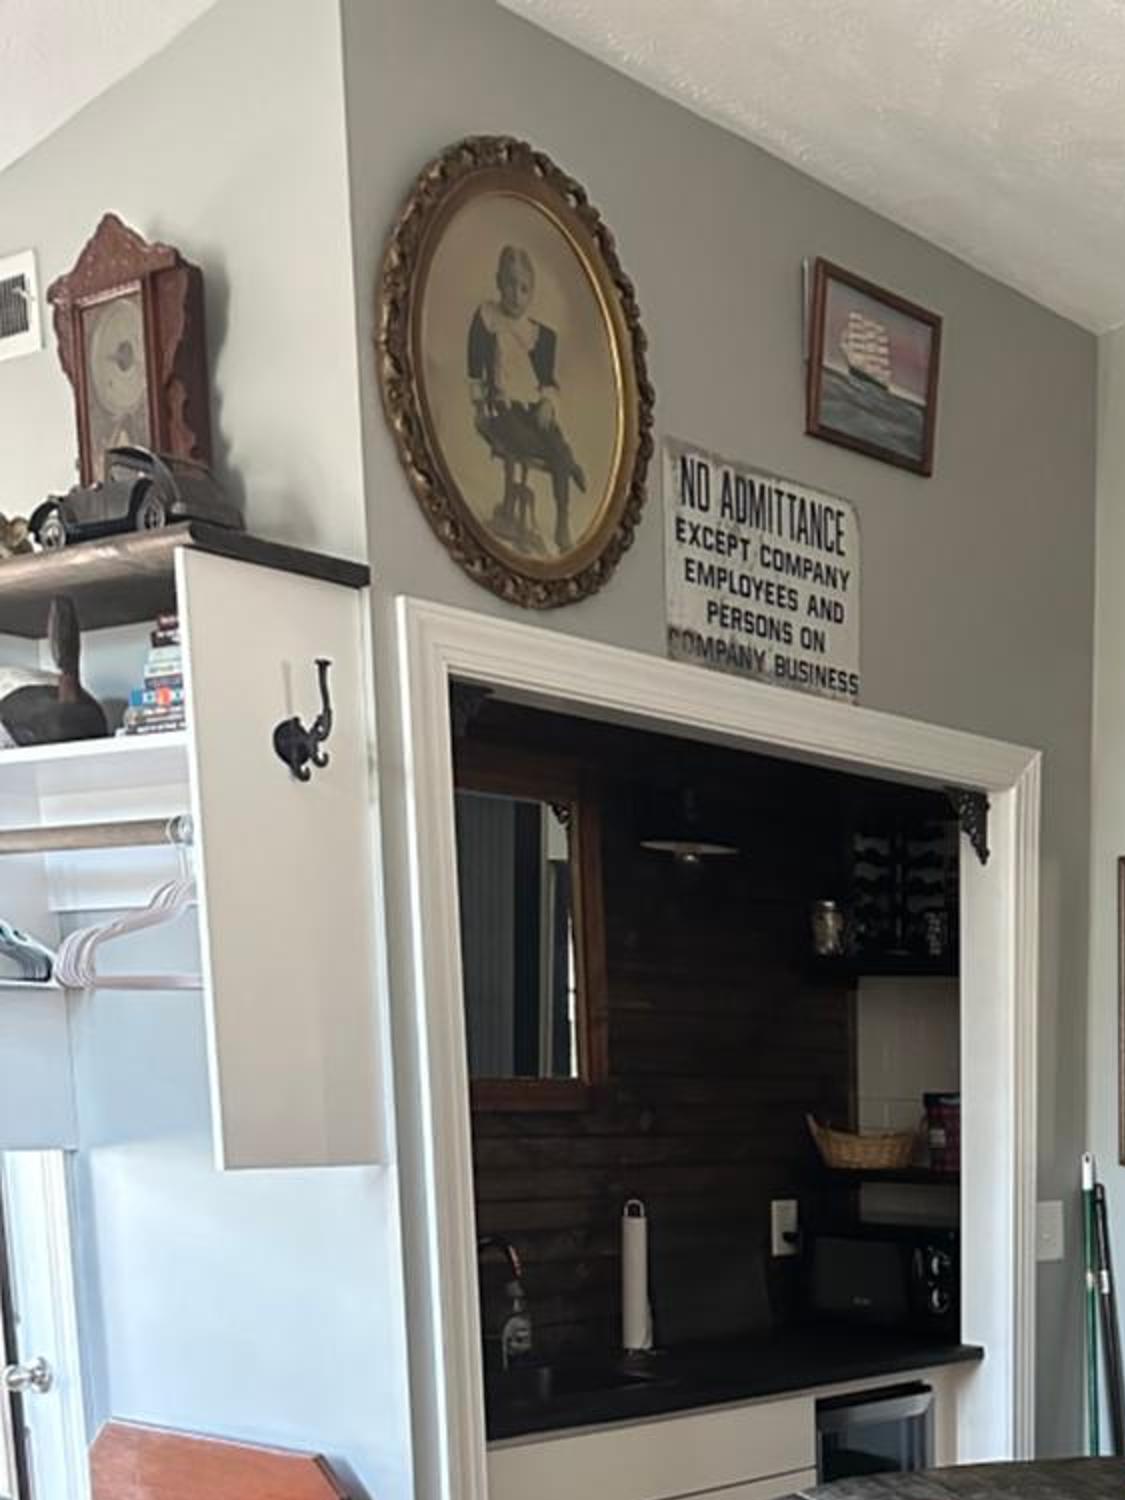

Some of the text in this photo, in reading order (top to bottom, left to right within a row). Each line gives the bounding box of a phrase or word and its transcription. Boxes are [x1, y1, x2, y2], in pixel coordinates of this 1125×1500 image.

[680, 455, 846, 557] NO ADMITTANCE
[675, 516, 851, 592] EXCEPT COMPANY
[684, 557, 844, 624] EMPLOYEES AND
[707, 600, 826, 654] PERSONS ON
[774, 654, 860, 695] BUSINESS
